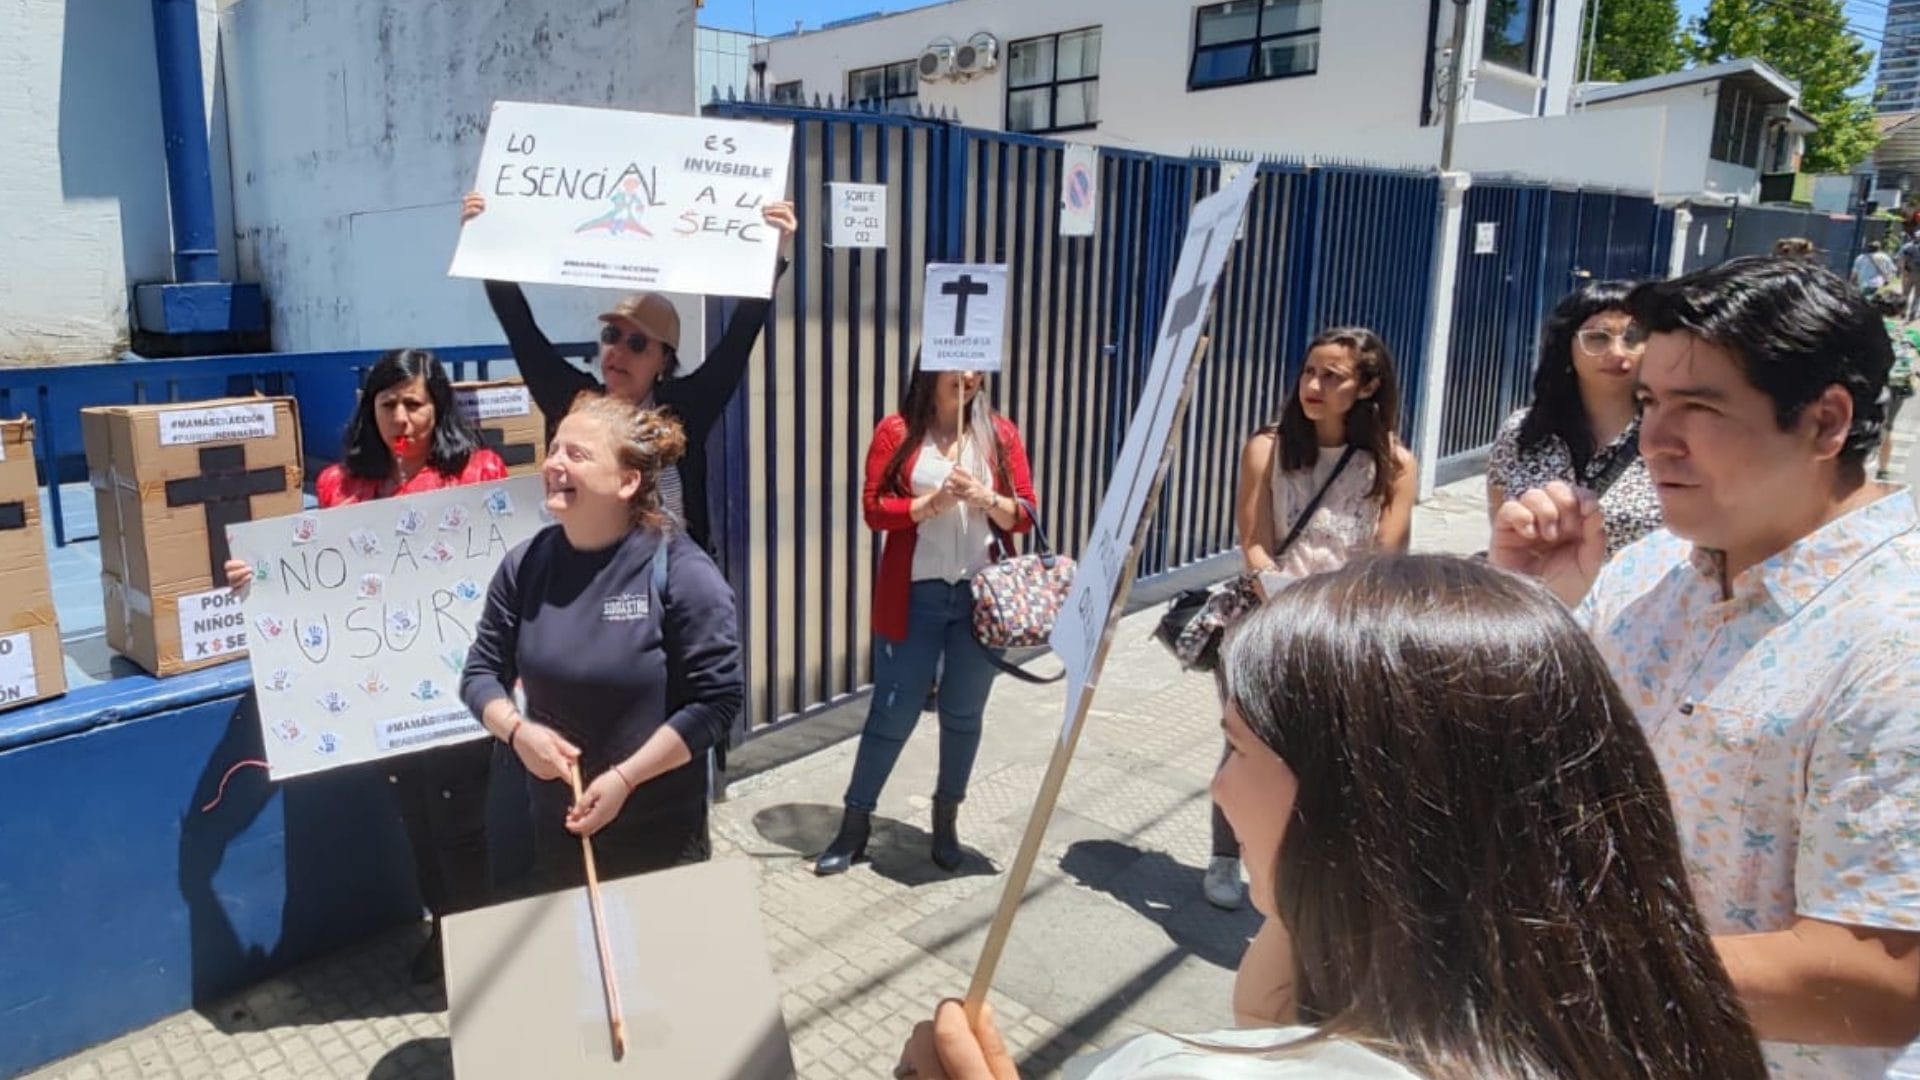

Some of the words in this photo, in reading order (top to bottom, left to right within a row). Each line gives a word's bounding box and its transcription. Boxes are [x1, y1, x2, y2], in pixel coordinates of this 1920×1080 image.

[507, 133, 536, 155] LO
[704, 135, 737, 155] ES
[684, 157, 774, 178] INVISIBLE
[695, 185, 716, 204] A
[279, 548, 347, 595] NO
[391, 537, 418, 575] A
[466, 523, 508, 560] LA
[201, 592, 236, 610] POR
[194, 612, 244, 635] NIÑOS
[294, 589, 472, 664] USUR
[196, 641, 208, 656] X
